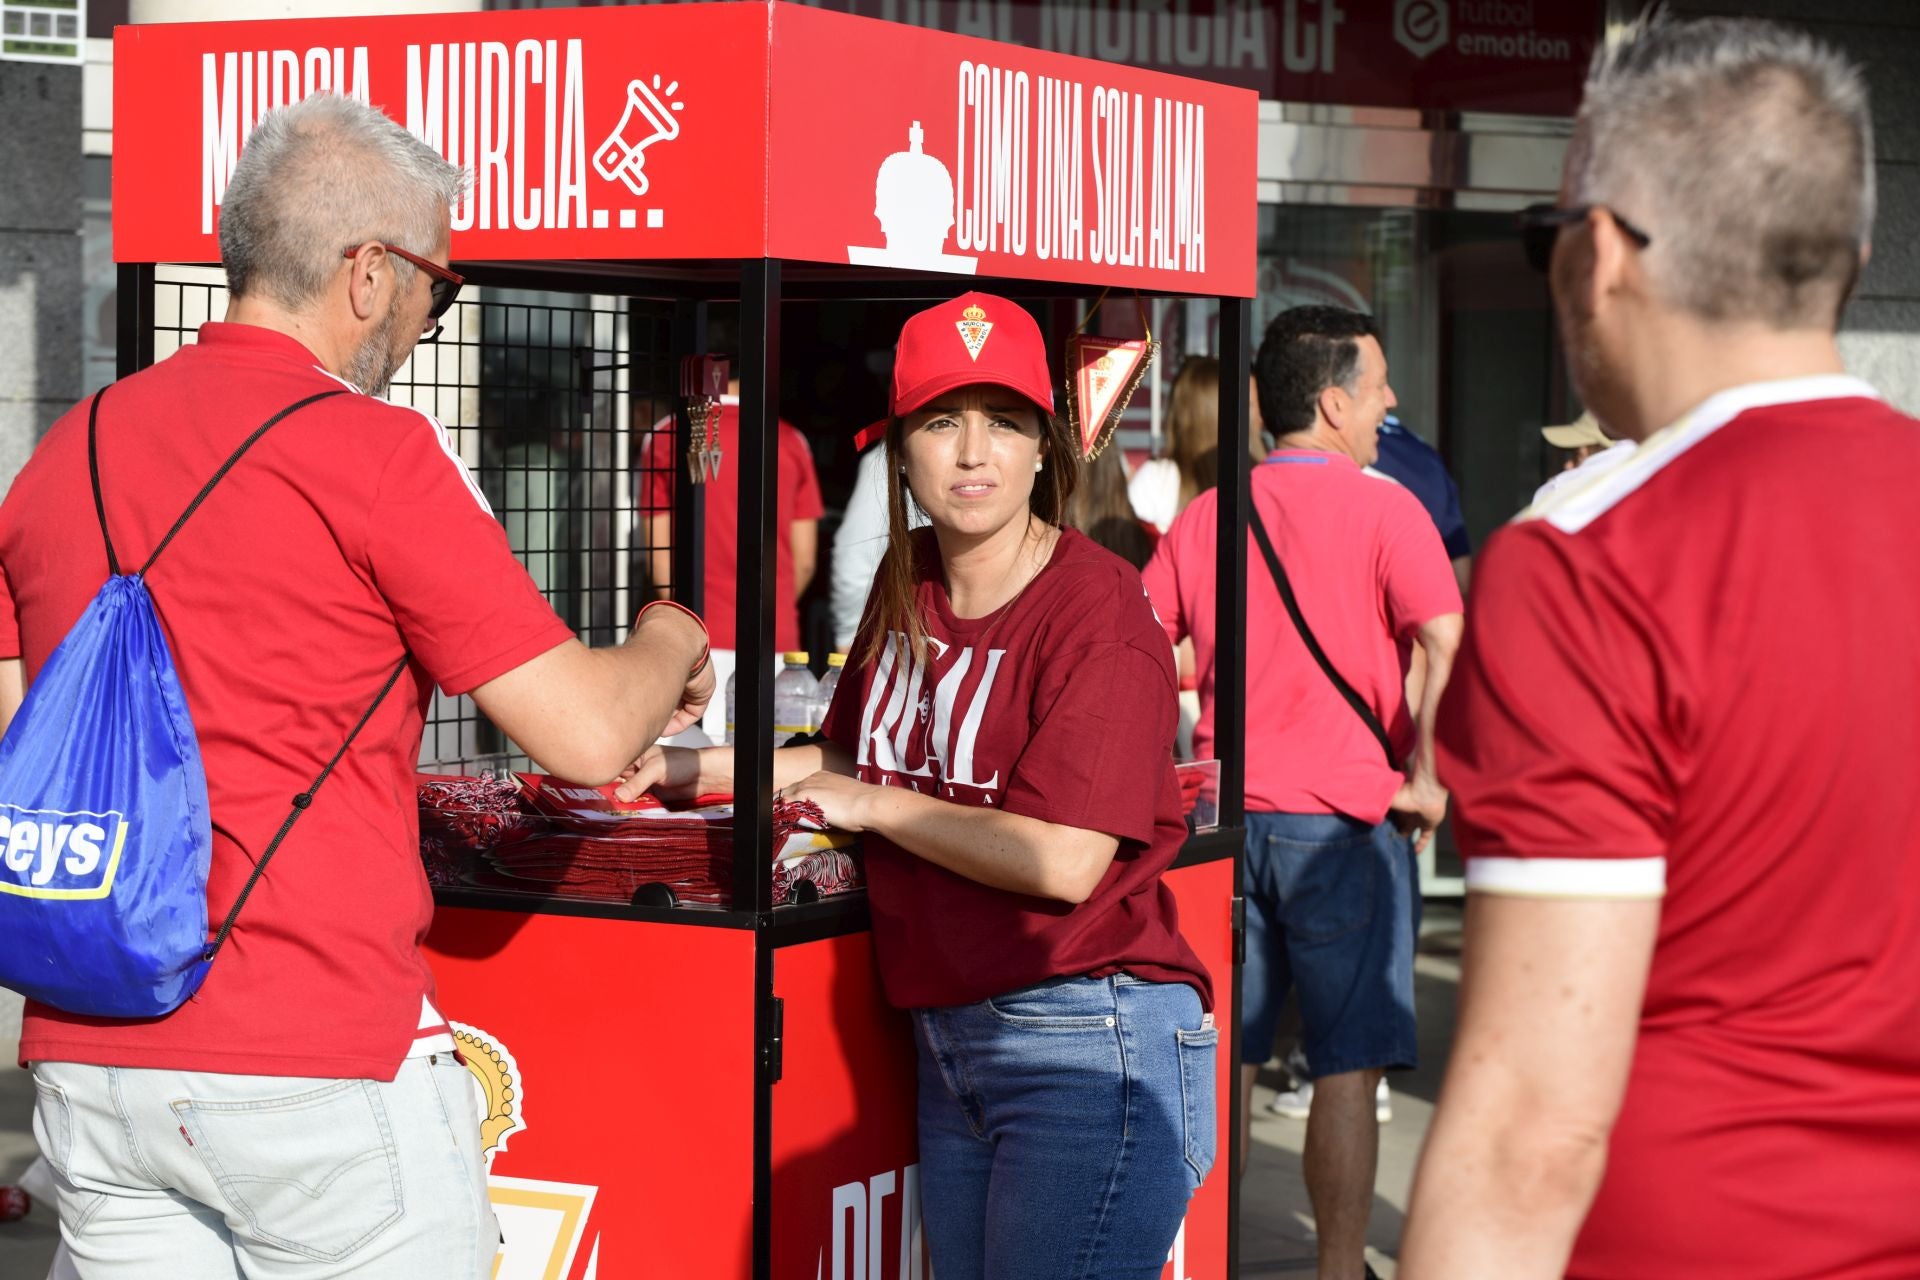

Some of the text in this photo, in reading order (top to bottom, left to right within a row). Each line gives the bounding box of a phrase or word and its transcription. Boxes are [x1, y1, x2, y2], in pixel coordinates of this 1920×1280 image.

[1456, 30, 1571, 60] emotion
[956, 60, 1205, 273] COMO UNA SOLA ALMA
[857, 630, 1006, 789] REAL
